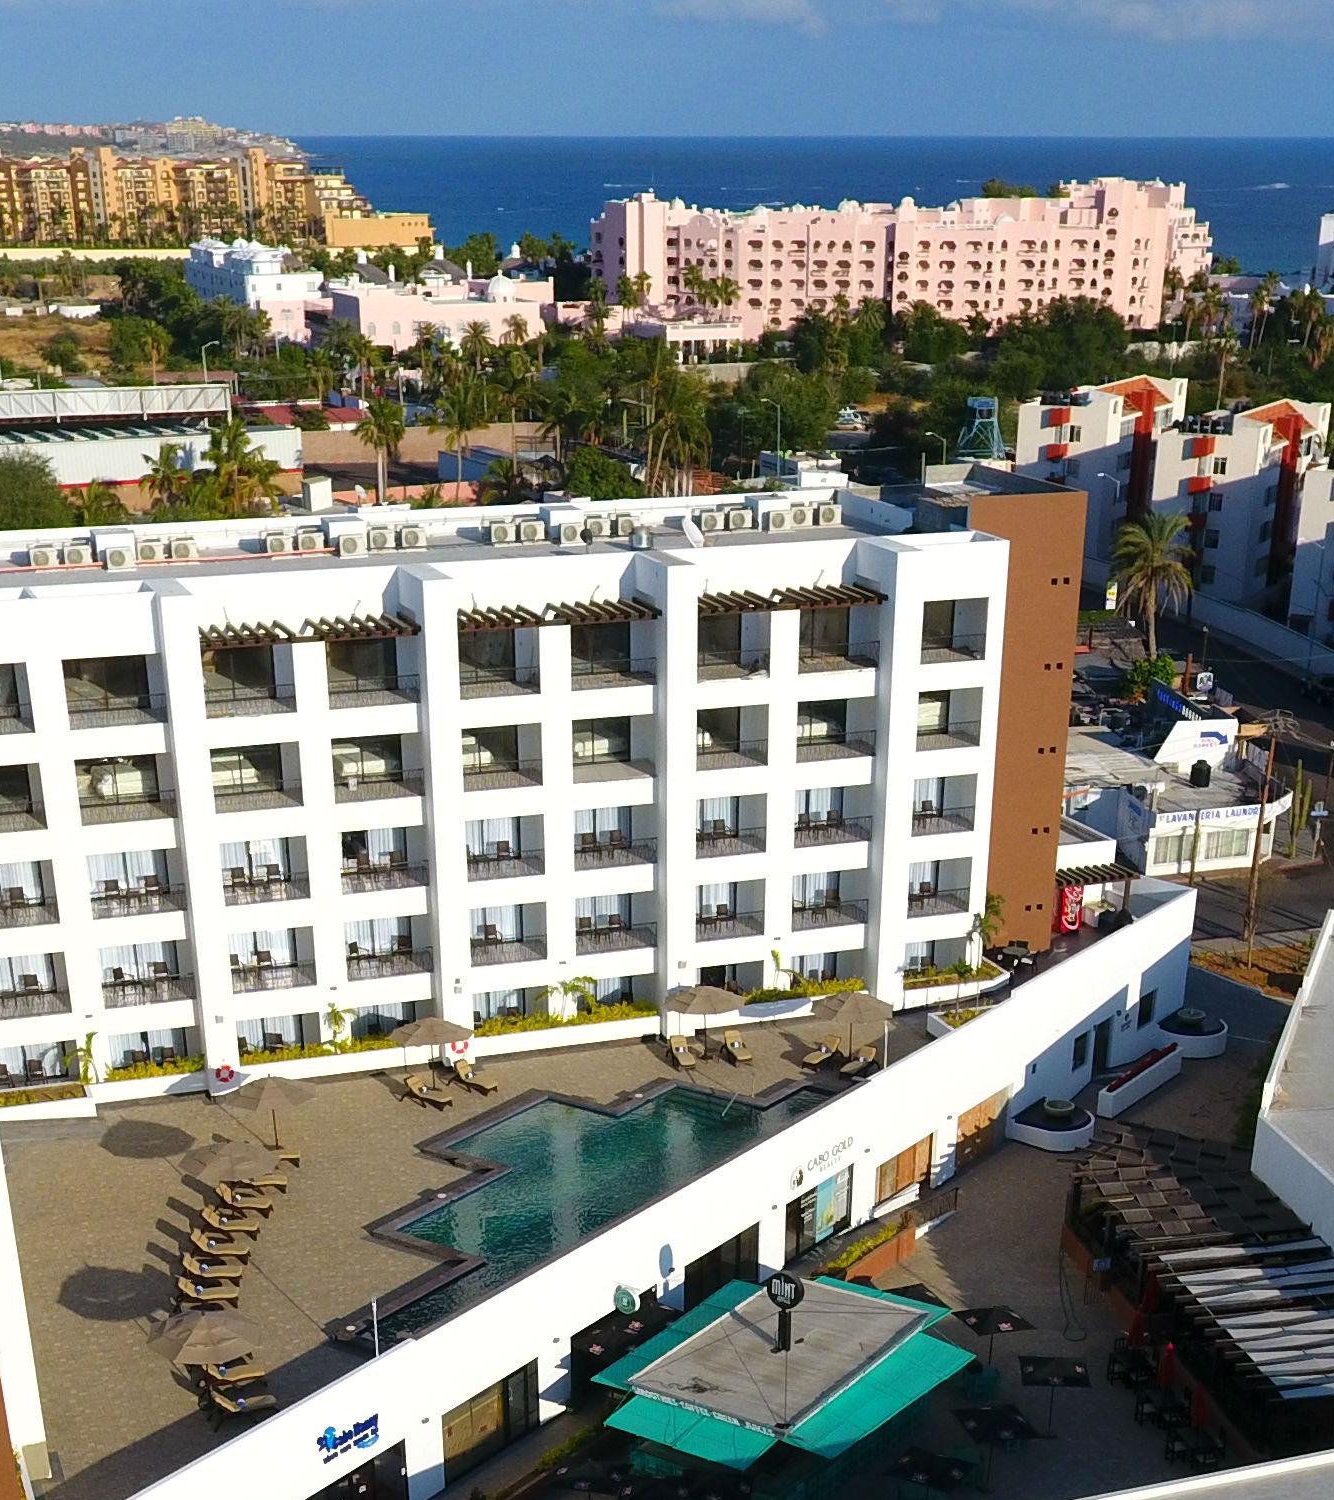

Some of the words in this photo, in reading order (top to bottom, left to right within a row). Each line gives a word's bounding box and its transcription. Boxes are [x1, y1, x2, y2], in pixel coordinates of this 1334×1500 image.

[1166, 810, 1221, 824] LAVANERIA
[807, 1151, 830, 1171] CABO
[831, 1136, 854, 1156] GOLD
